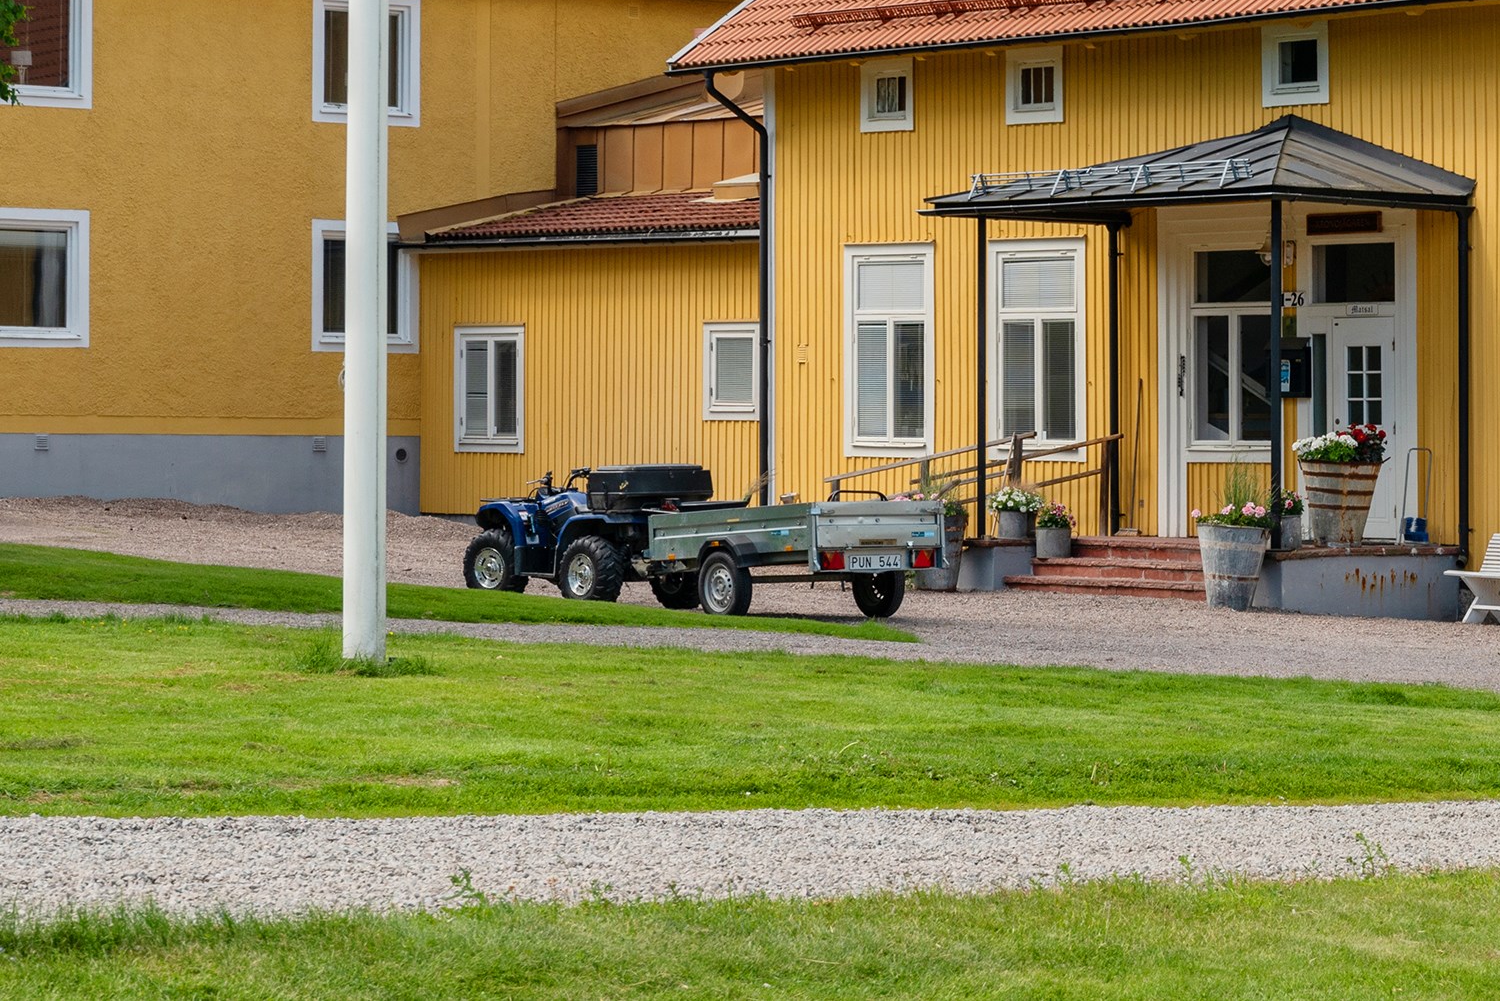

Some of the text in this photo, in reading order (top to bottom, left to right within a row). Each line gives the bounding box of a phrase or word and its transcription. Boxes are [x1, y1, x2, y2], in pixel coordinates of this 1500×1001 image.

[1351, 305, 1374, 314] Matsal
[851, 556, 899, 568] PUN 544
